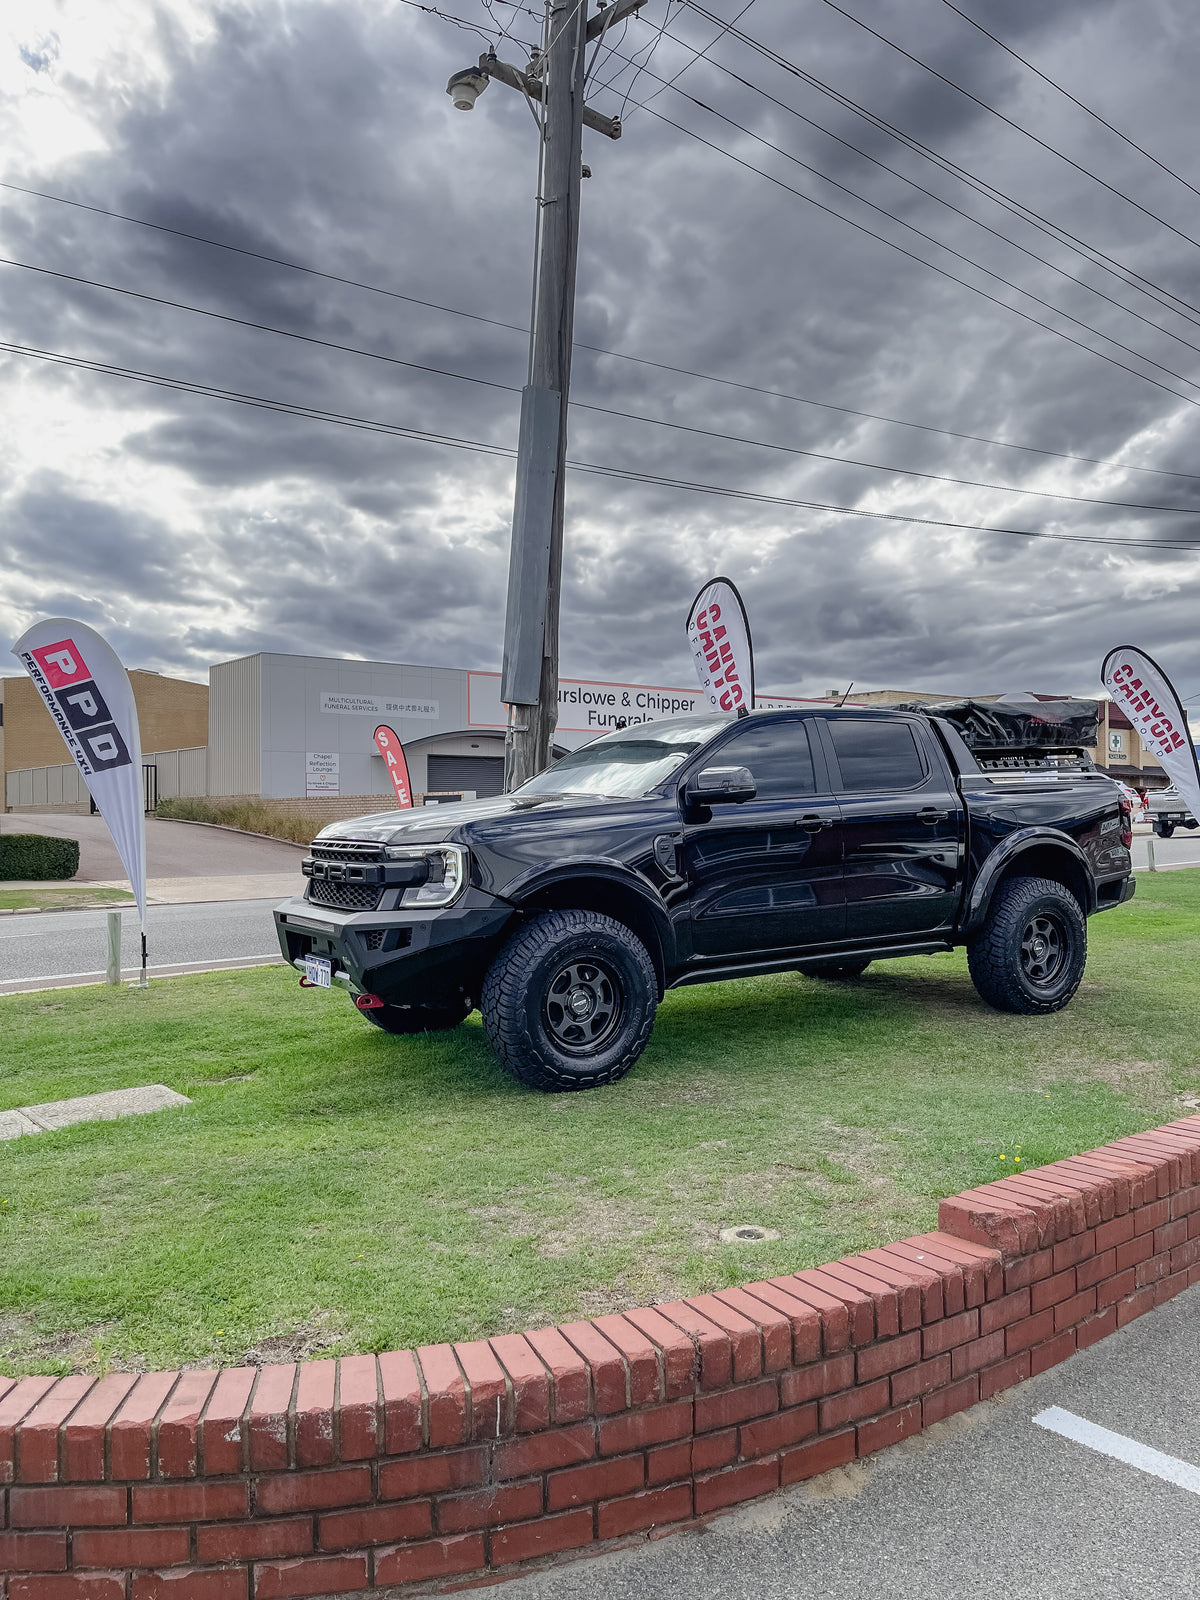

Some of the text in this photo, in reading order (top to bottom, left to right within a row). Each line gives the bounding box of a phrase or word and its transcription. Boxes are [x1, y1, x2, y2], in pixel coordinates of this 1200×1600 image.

[689, 622, 717, 705] OFF-RO
[697, 604, 746, 711] CANYO
[21, 652, 92, 776] PERFORMANCE 4X4
[42, 648, 120, 763] PPD
[324, 703, 350, 711] FUNERAL
[328, 697, 374, 705] MULTICULTURAL
[558, 687, 695, 713] urslowe & Chipper
[1113, 664, 1186, 755] CANYON
[377, 731, 410, 805] SALE
